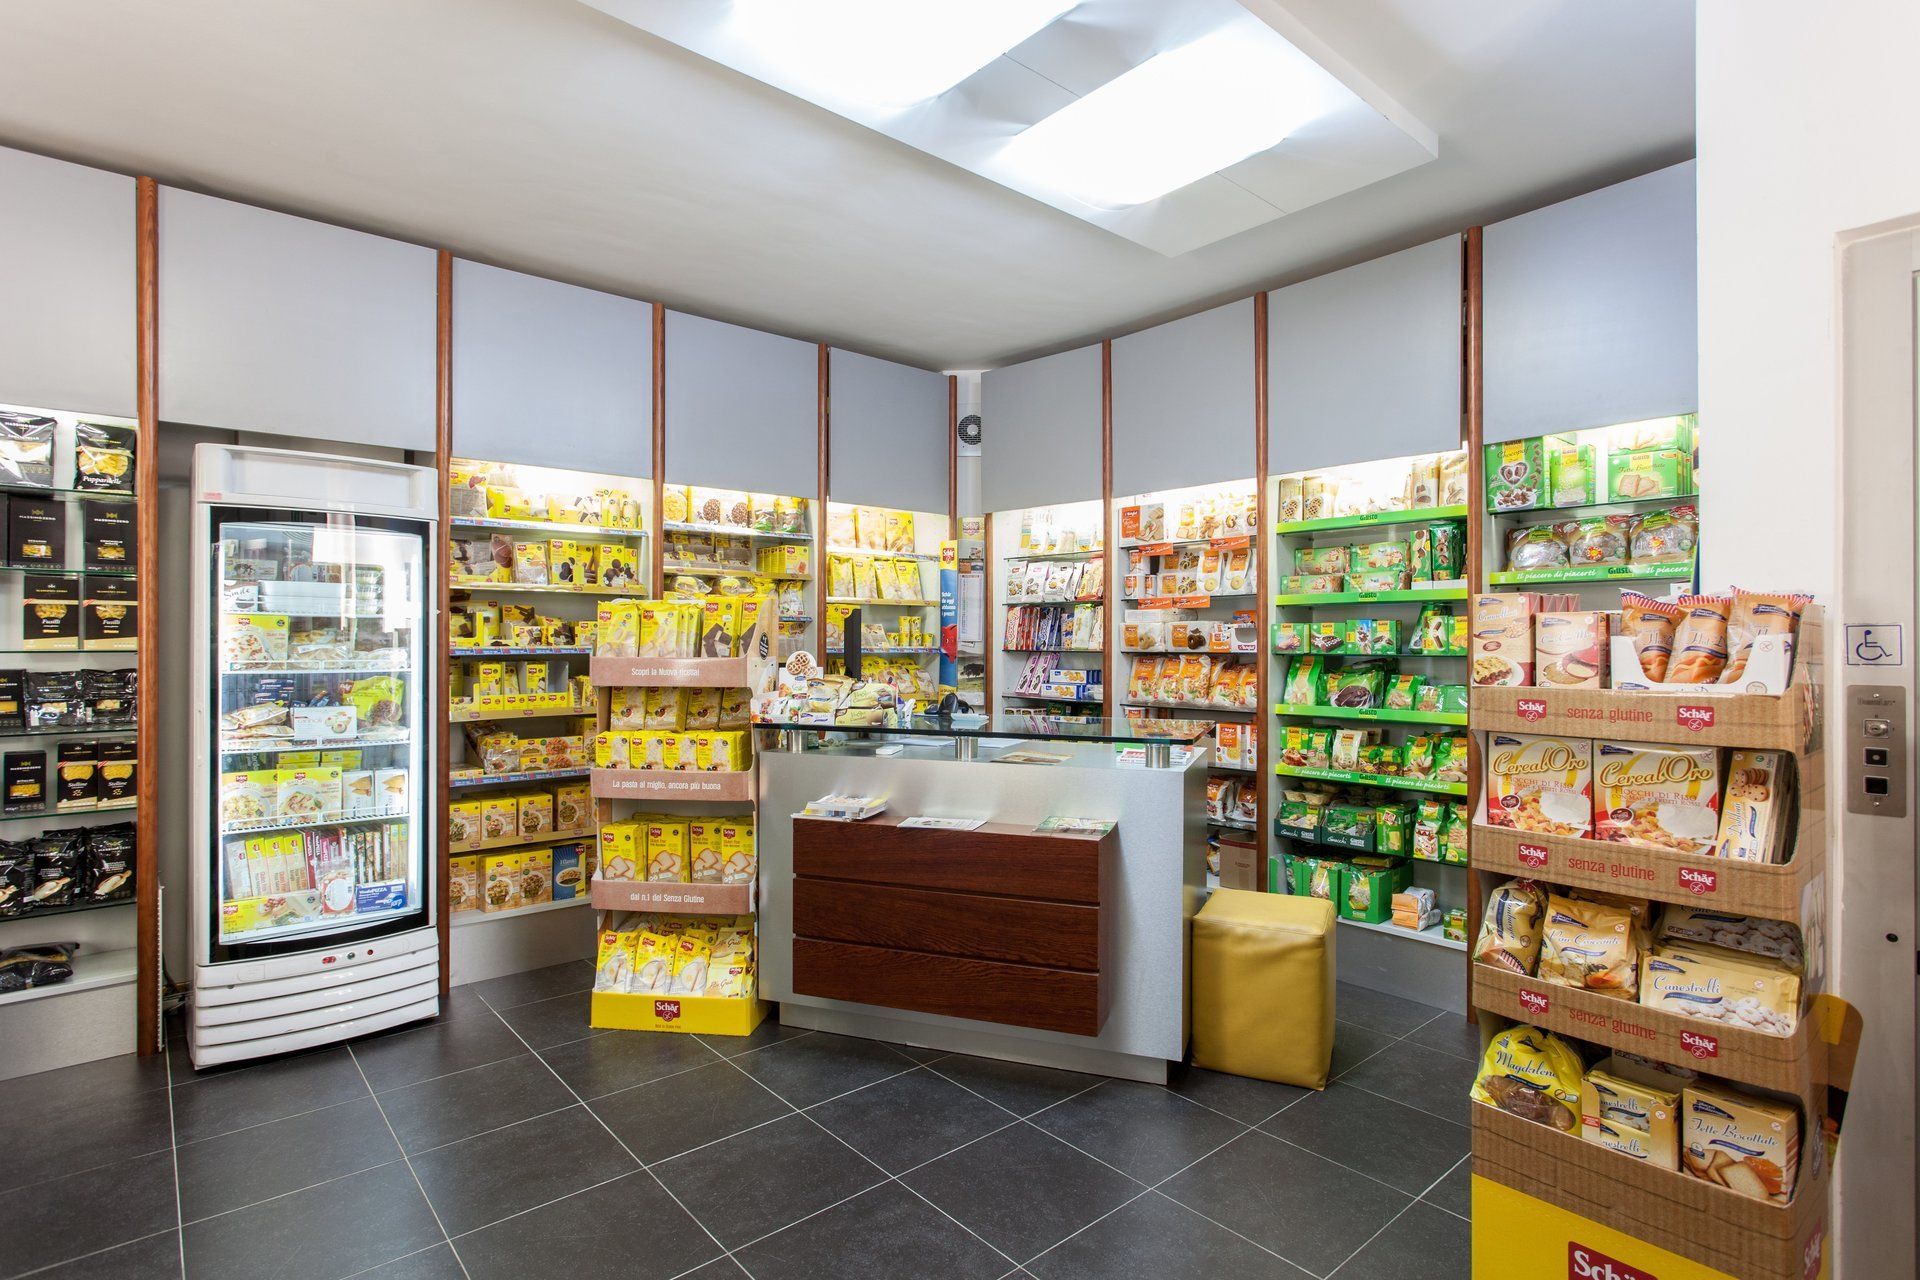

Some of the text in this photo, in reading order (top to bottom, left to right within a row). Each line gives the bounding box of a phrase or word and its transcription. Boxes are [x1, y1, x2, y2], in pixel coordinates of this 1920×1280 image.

[1518, 700, 1546, 713] Schär
[1679, 707, 1712, 722] Schär
[1567, 707, 1653, 723] senza glutine
[1520, 845, 1547, 860] Schär
[1568, 857, 1655, 881] senza glutine
[1681, 869, 1715, 885] Schär
[663, 893, 682, 903] Senza
[1653, 975, 1720, 994] Canestrelli
[656, 1002, 679, 1013] Schär
[1521, 991, 1548, 1008] Schär
[1569, 1008, 1657, 1041] senza glutine
[1682, 1032, 1716, 1050] Schär
[1722, 1123, 1778, 1146] Biscottate
[1574, 1250, 1636, 1280] Sch
